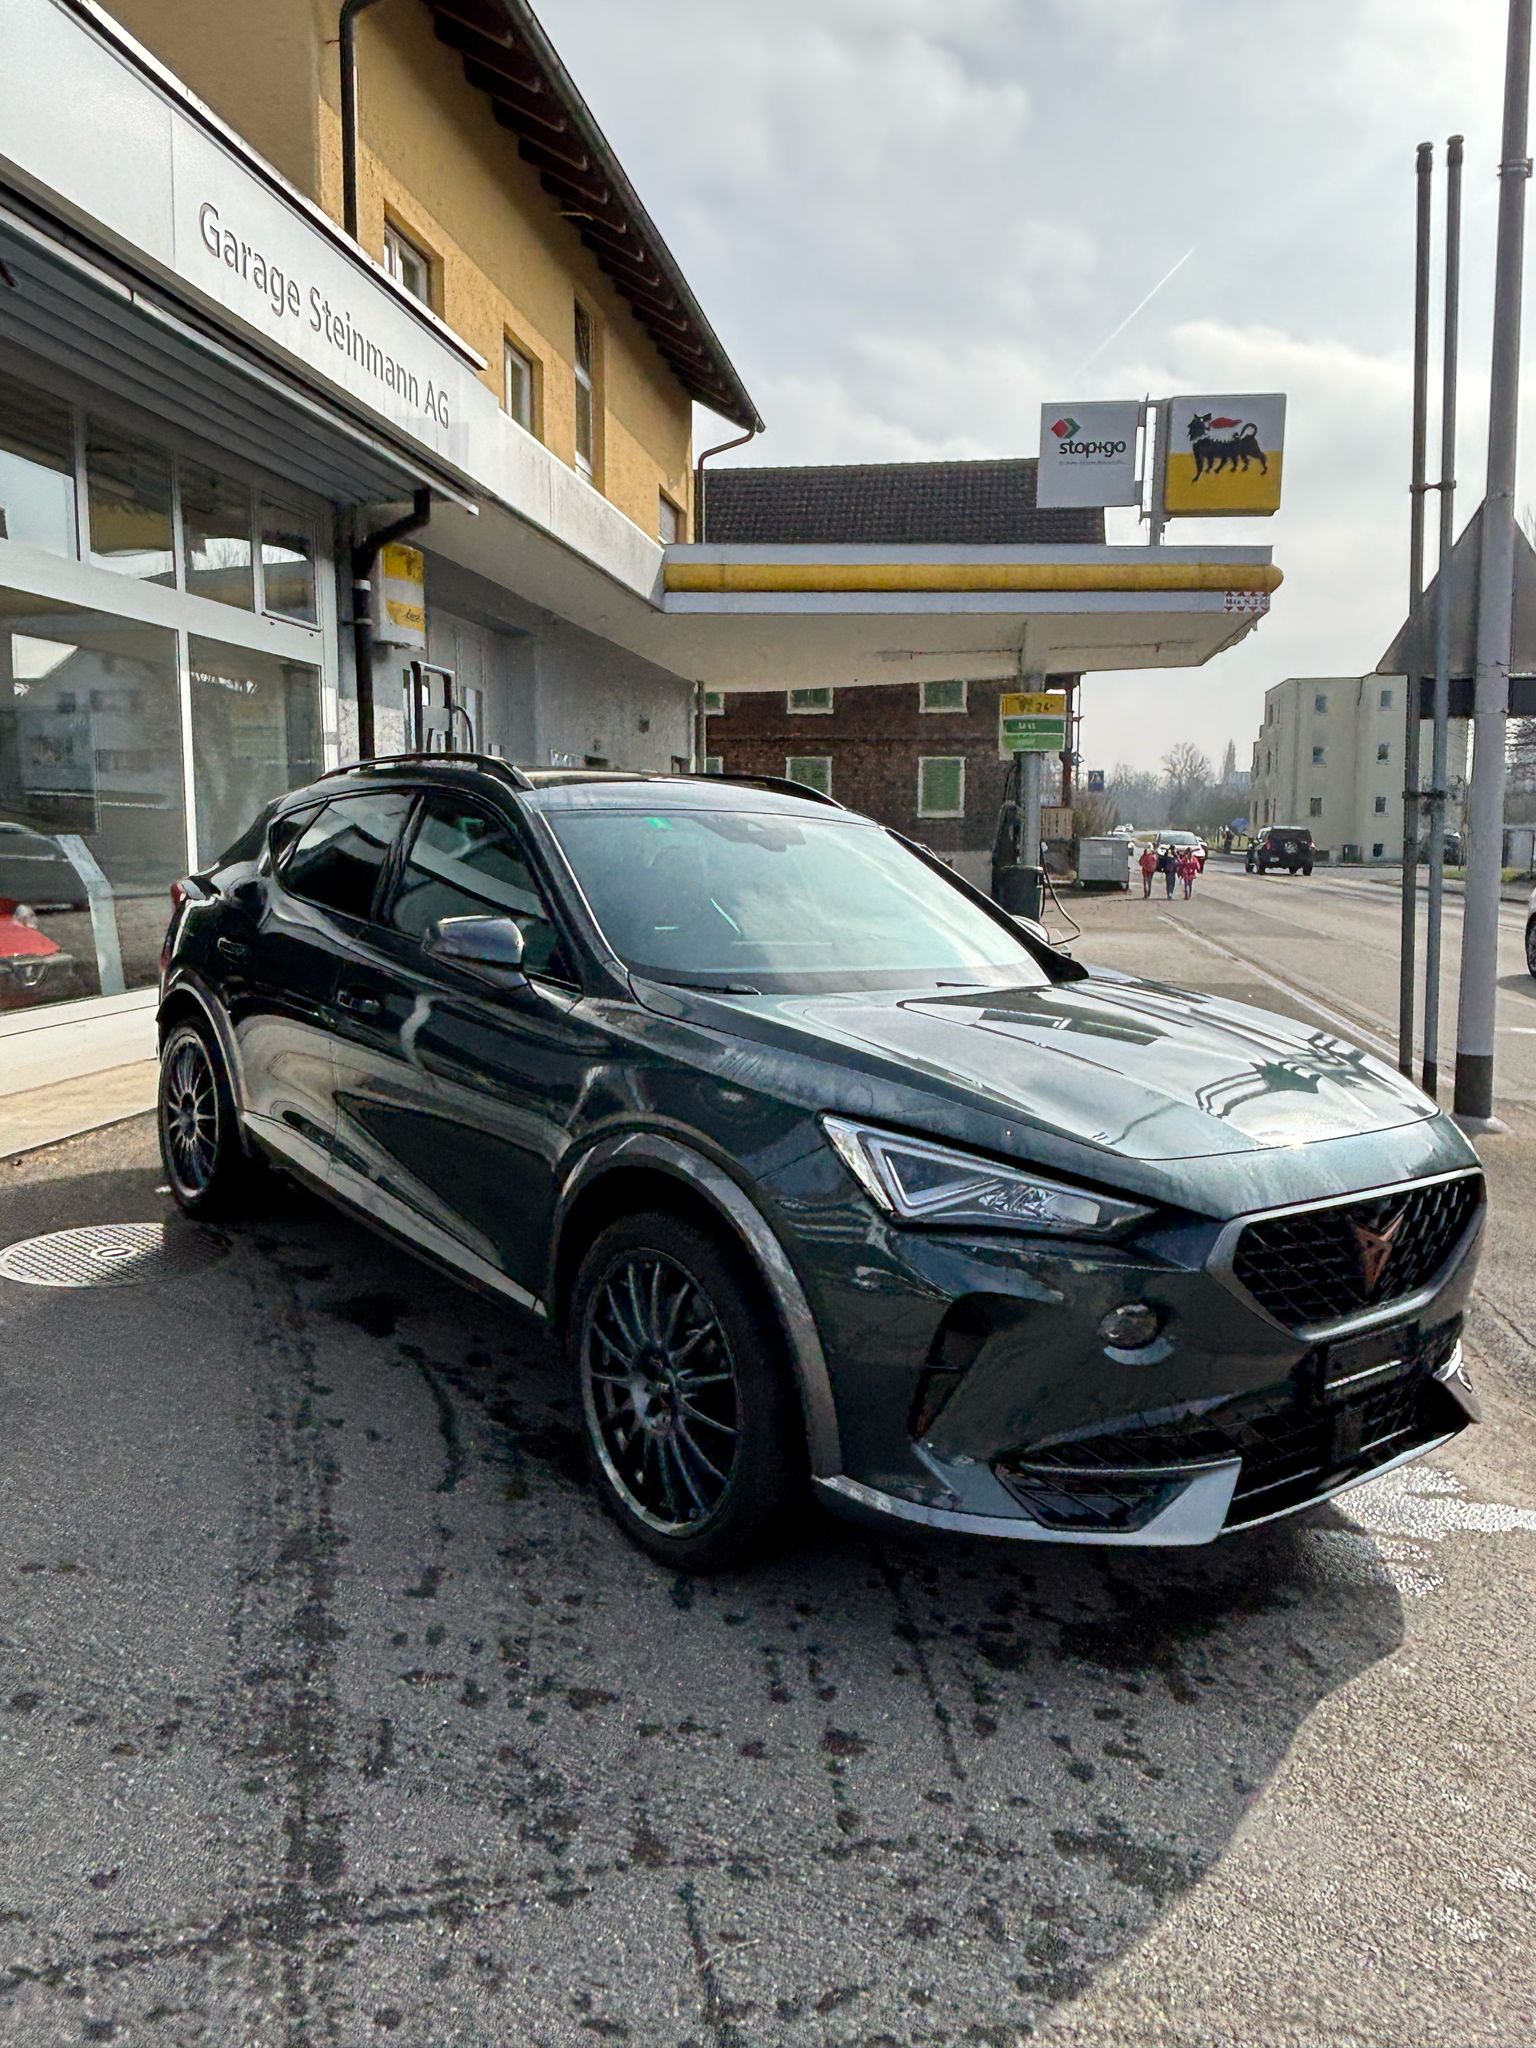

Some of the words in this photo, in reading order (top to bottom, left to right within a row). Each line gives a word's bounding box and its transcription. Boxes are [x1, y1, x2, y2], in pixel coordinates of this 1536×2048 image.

[199, 202, 301, 317] Garage
[309, 286, 419, 408] Steinmann
[424, 380, 449, 429] AG
[1059, 440, 1127, 458] stop+go
